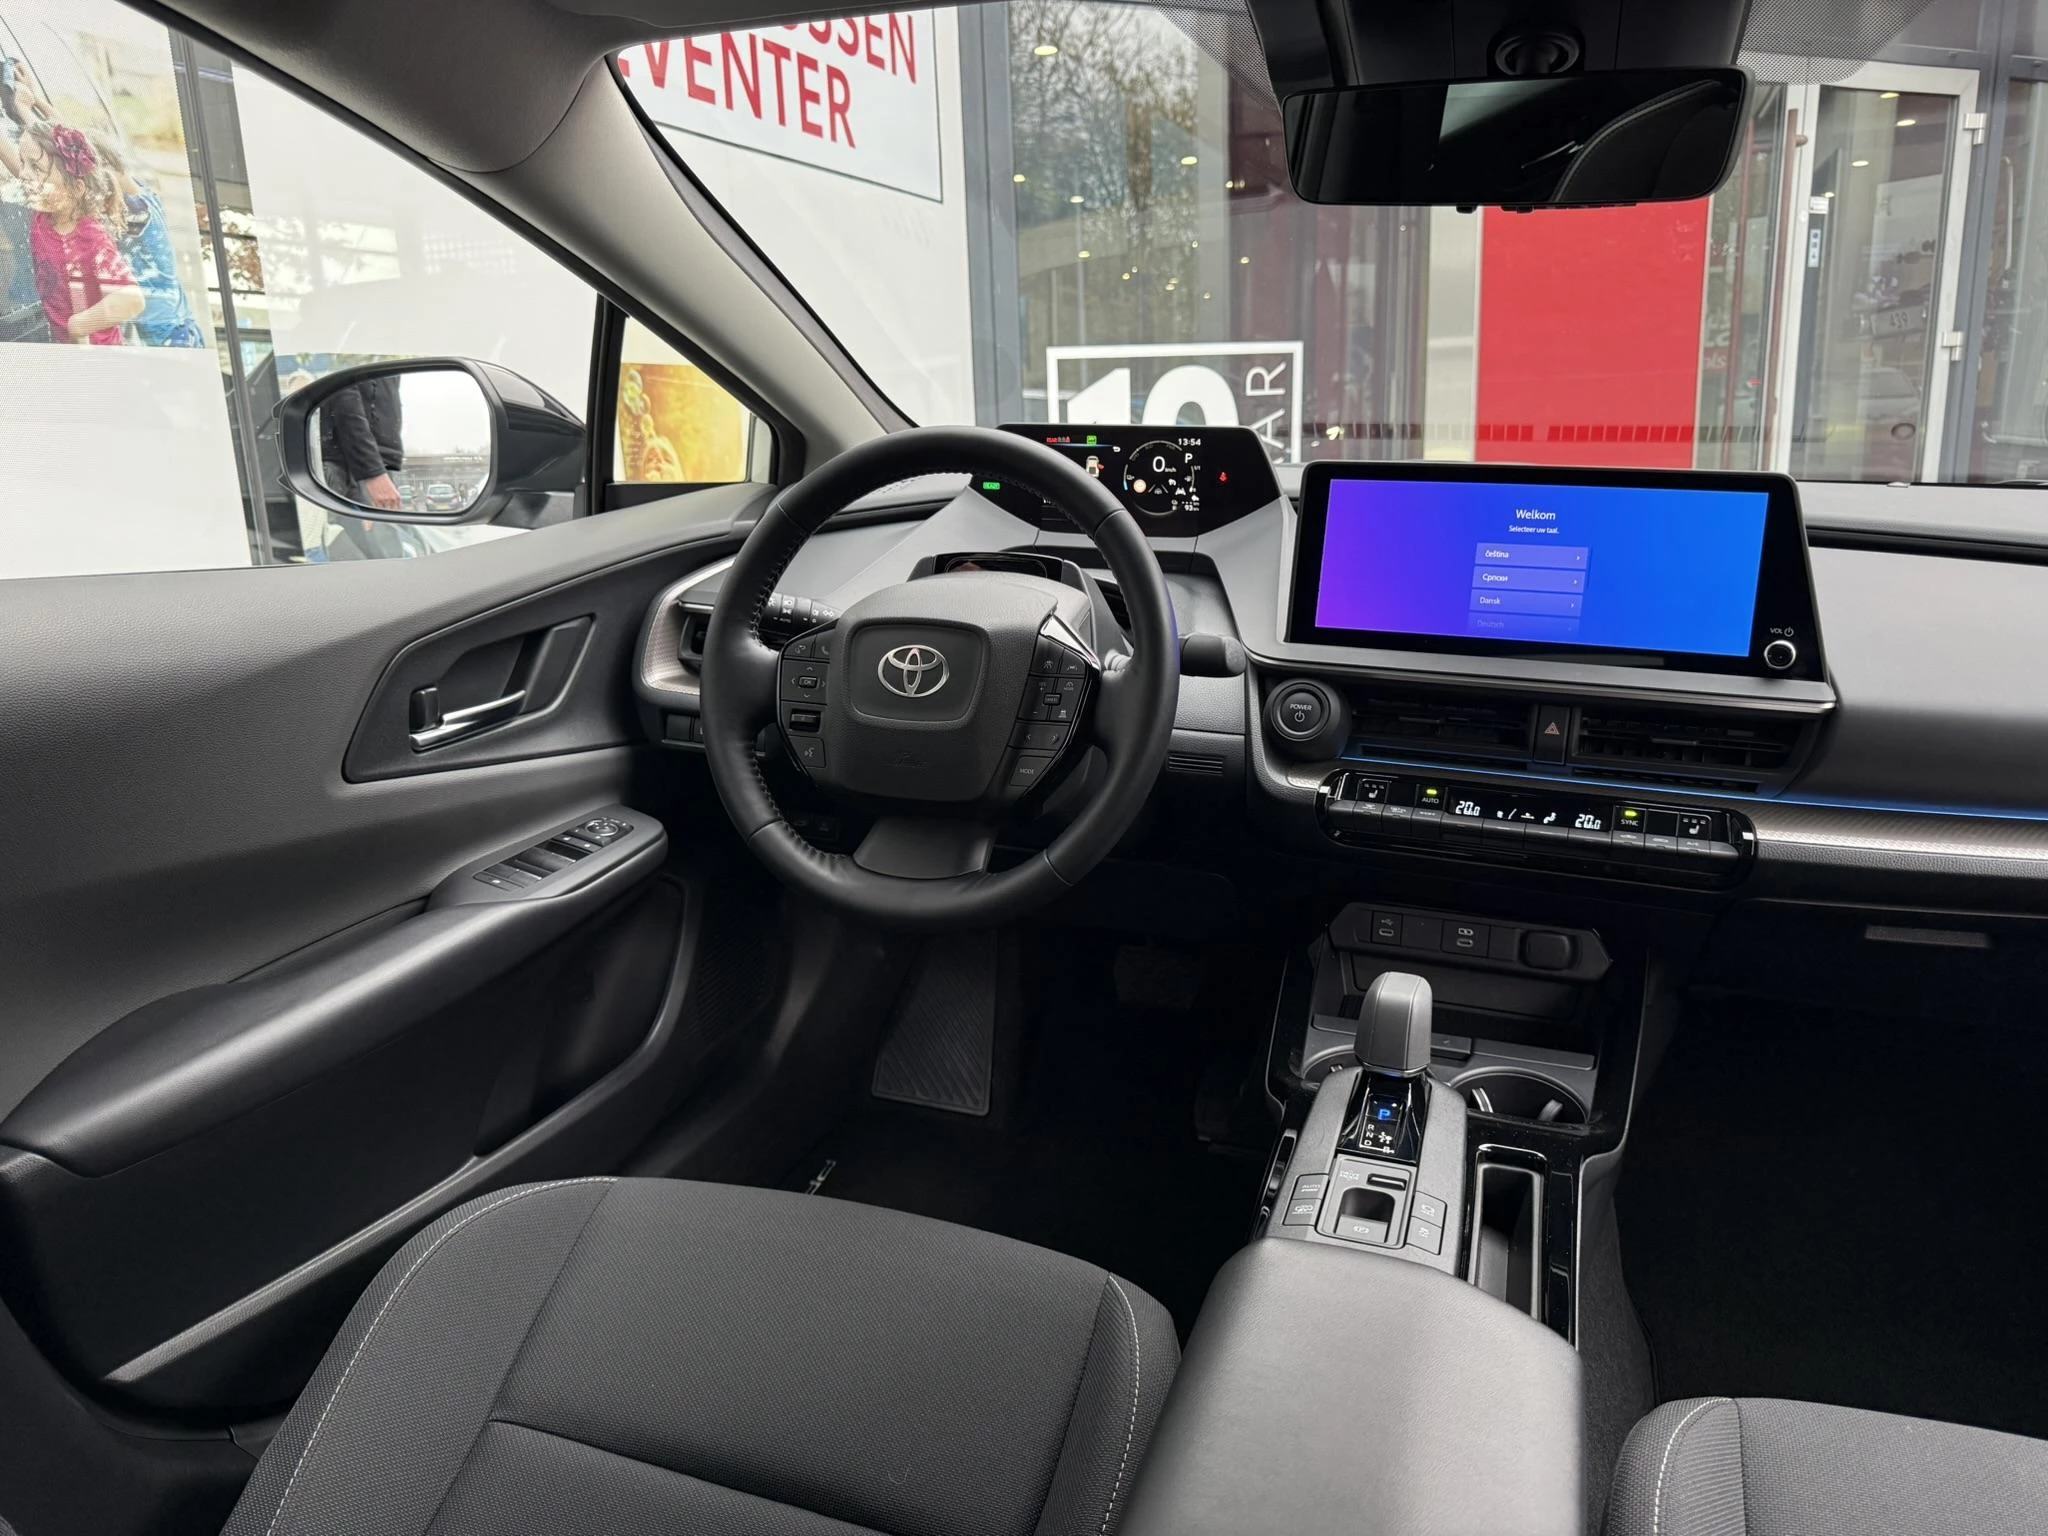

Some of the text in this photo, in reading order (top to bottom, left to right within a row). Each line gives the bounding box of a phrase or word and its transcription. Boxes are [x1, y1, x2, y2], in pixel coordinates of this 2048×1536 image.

[1178, 438, 1201, 446] 13:54
[1184, 453, 1193, 464] P
[1152, 455, 1166, 473] 0
[1515, 508, 1556, 520] Welkom
[1508, 524, 1536, 533] Selecteer
[1479, 596, 1501, 605] Dansk
[1290, 703, 1312, 711] POWER
[1020, 767, 1035, 775] MODE
[1455, 801, 1481, 817] 20.0
[1574, 813, 1602, 830] 20.0
[1620, 819, 1639, 827] SYNC
[1377, 1108, 1392, 1120] P
[1367, 1123, 1375, 1131] R
[1365, 1131, 1374, 1139] N
